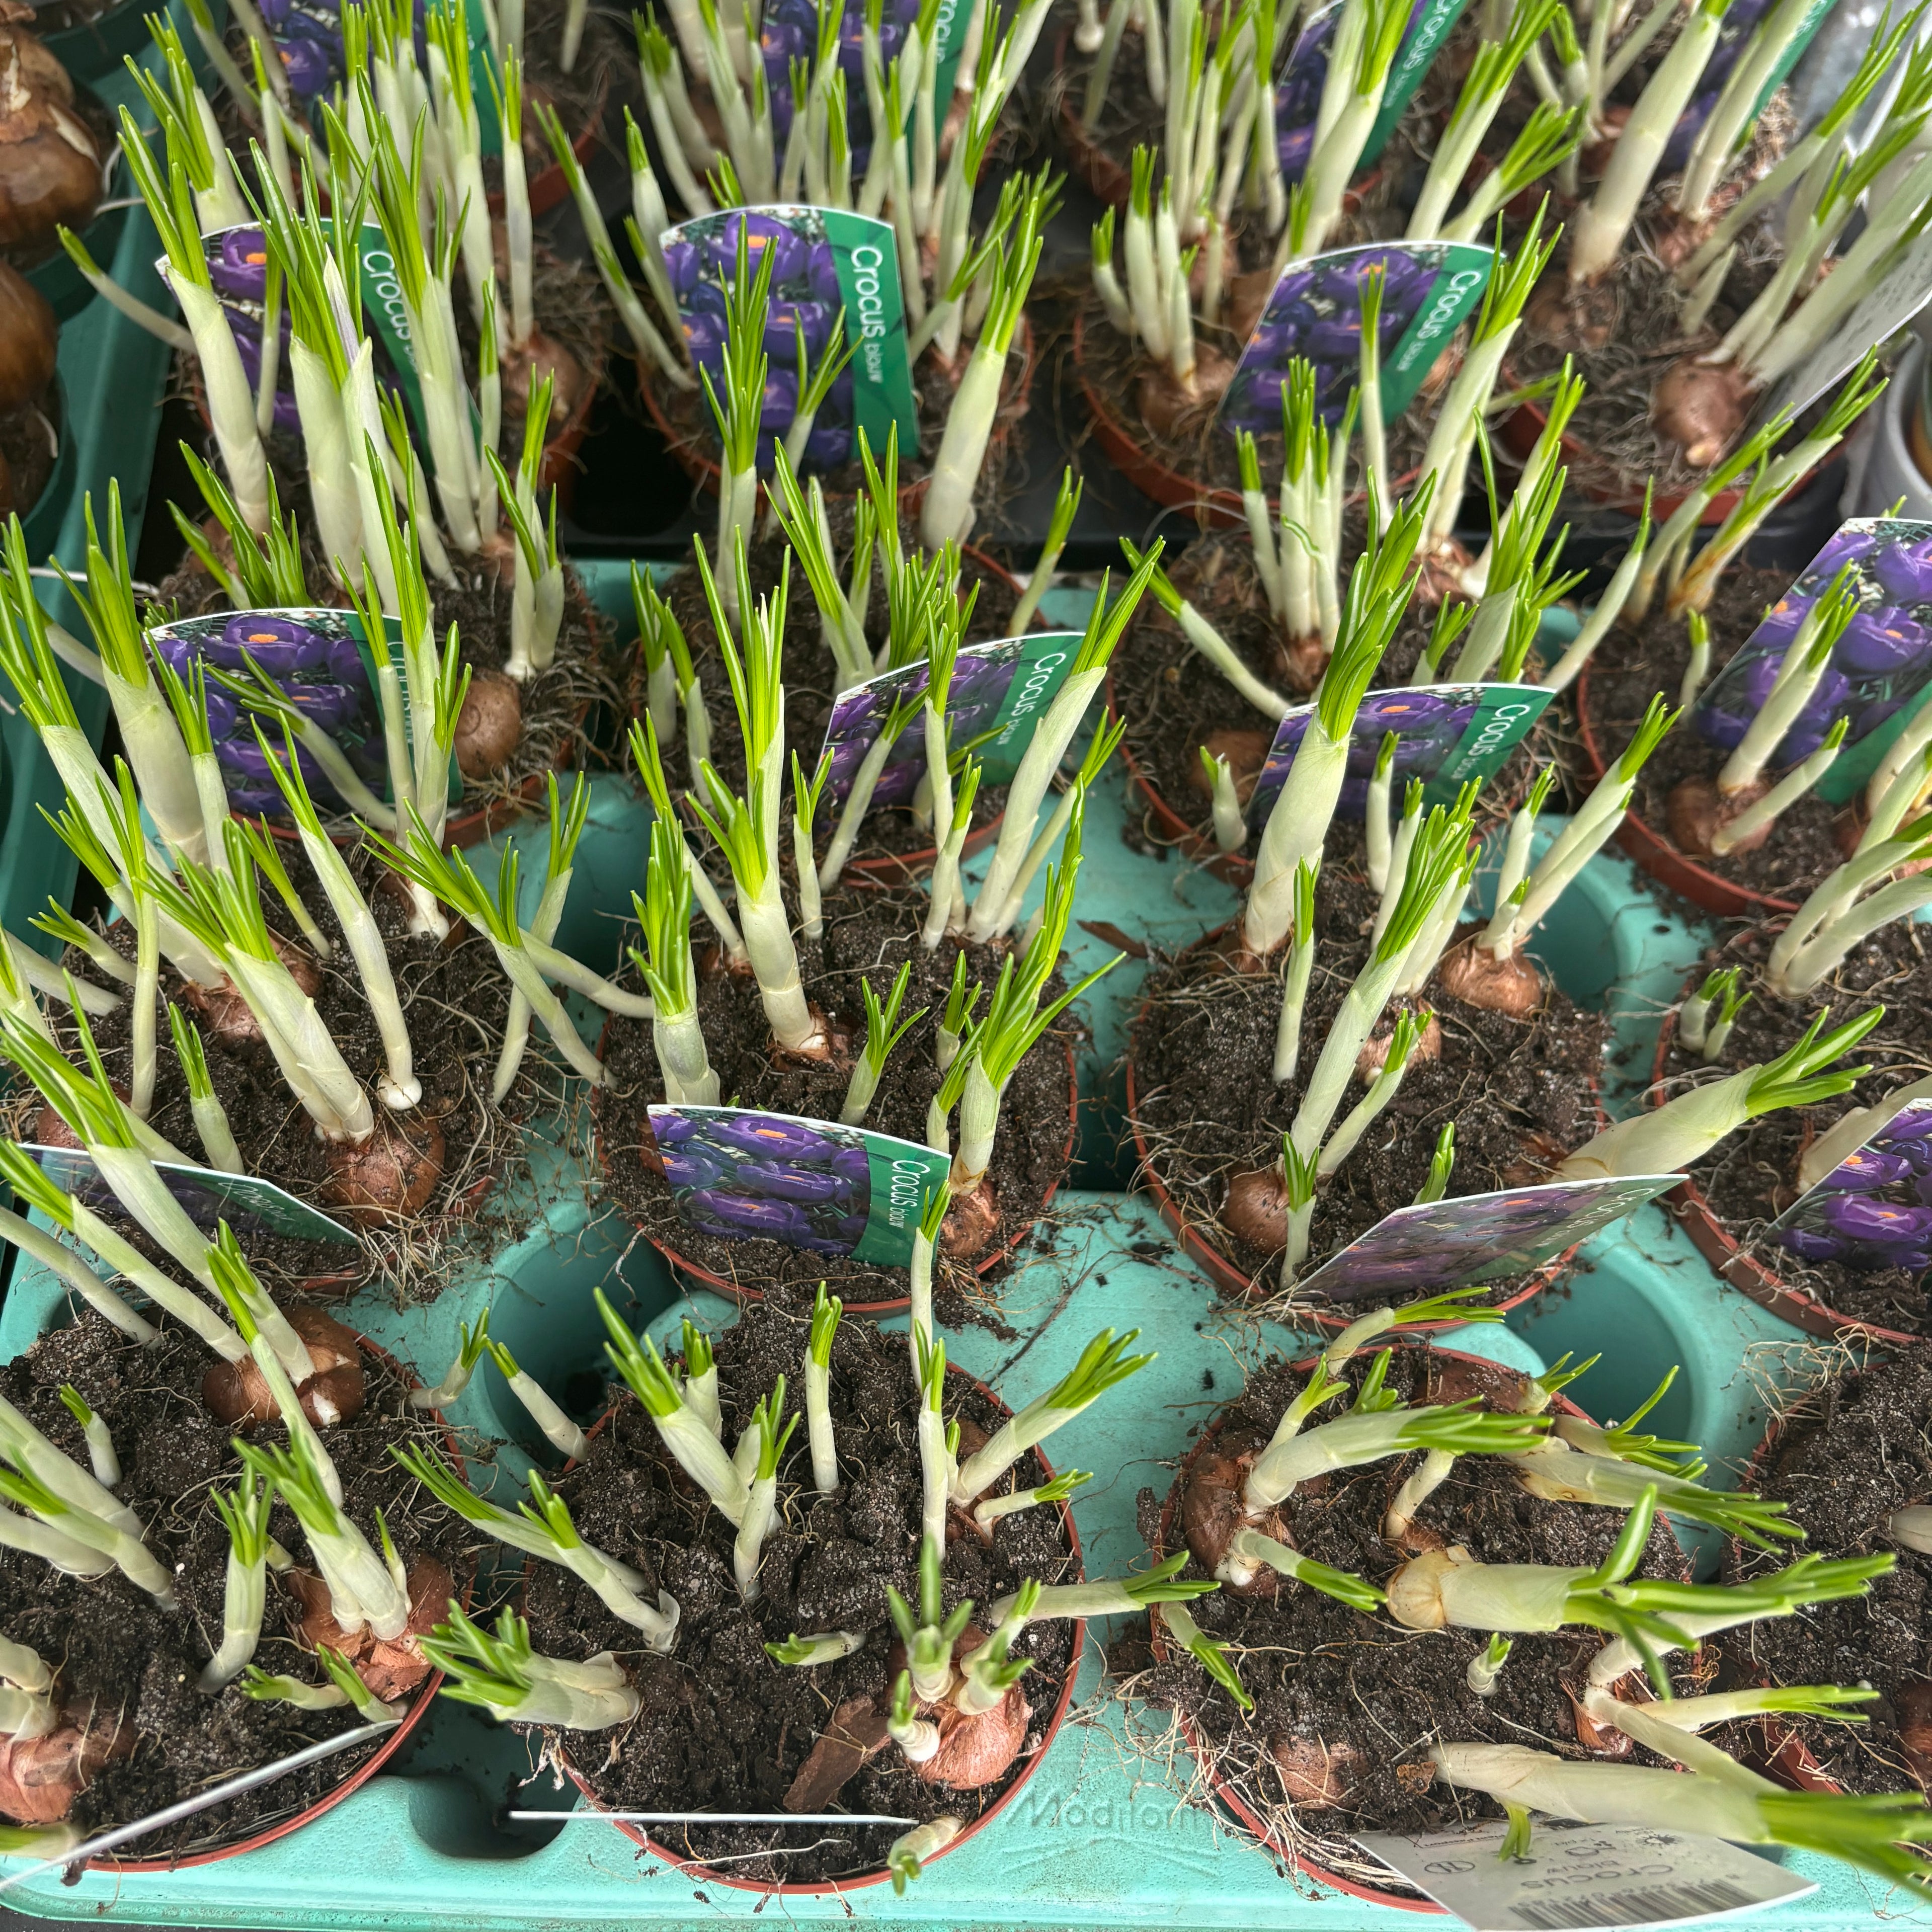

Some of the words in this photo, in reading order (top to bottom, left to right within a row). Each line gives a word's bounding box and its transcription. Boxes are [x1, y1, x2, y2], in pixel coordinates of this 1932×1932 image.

[851, 246, 886, 338] Crocus
[1416, 270, 1482, 340] Crocus
[1011, 653, 1067, 716] Crocus
[1468, 704, 1531, 756] Crocus
[890, 1160, 931, 1207] Crocus
[889, 1207, 910, 1229] blauw
[1566, 1188, 1656, 1229] Crocus
[1520, 1864, 1673, 1889] Crocus
